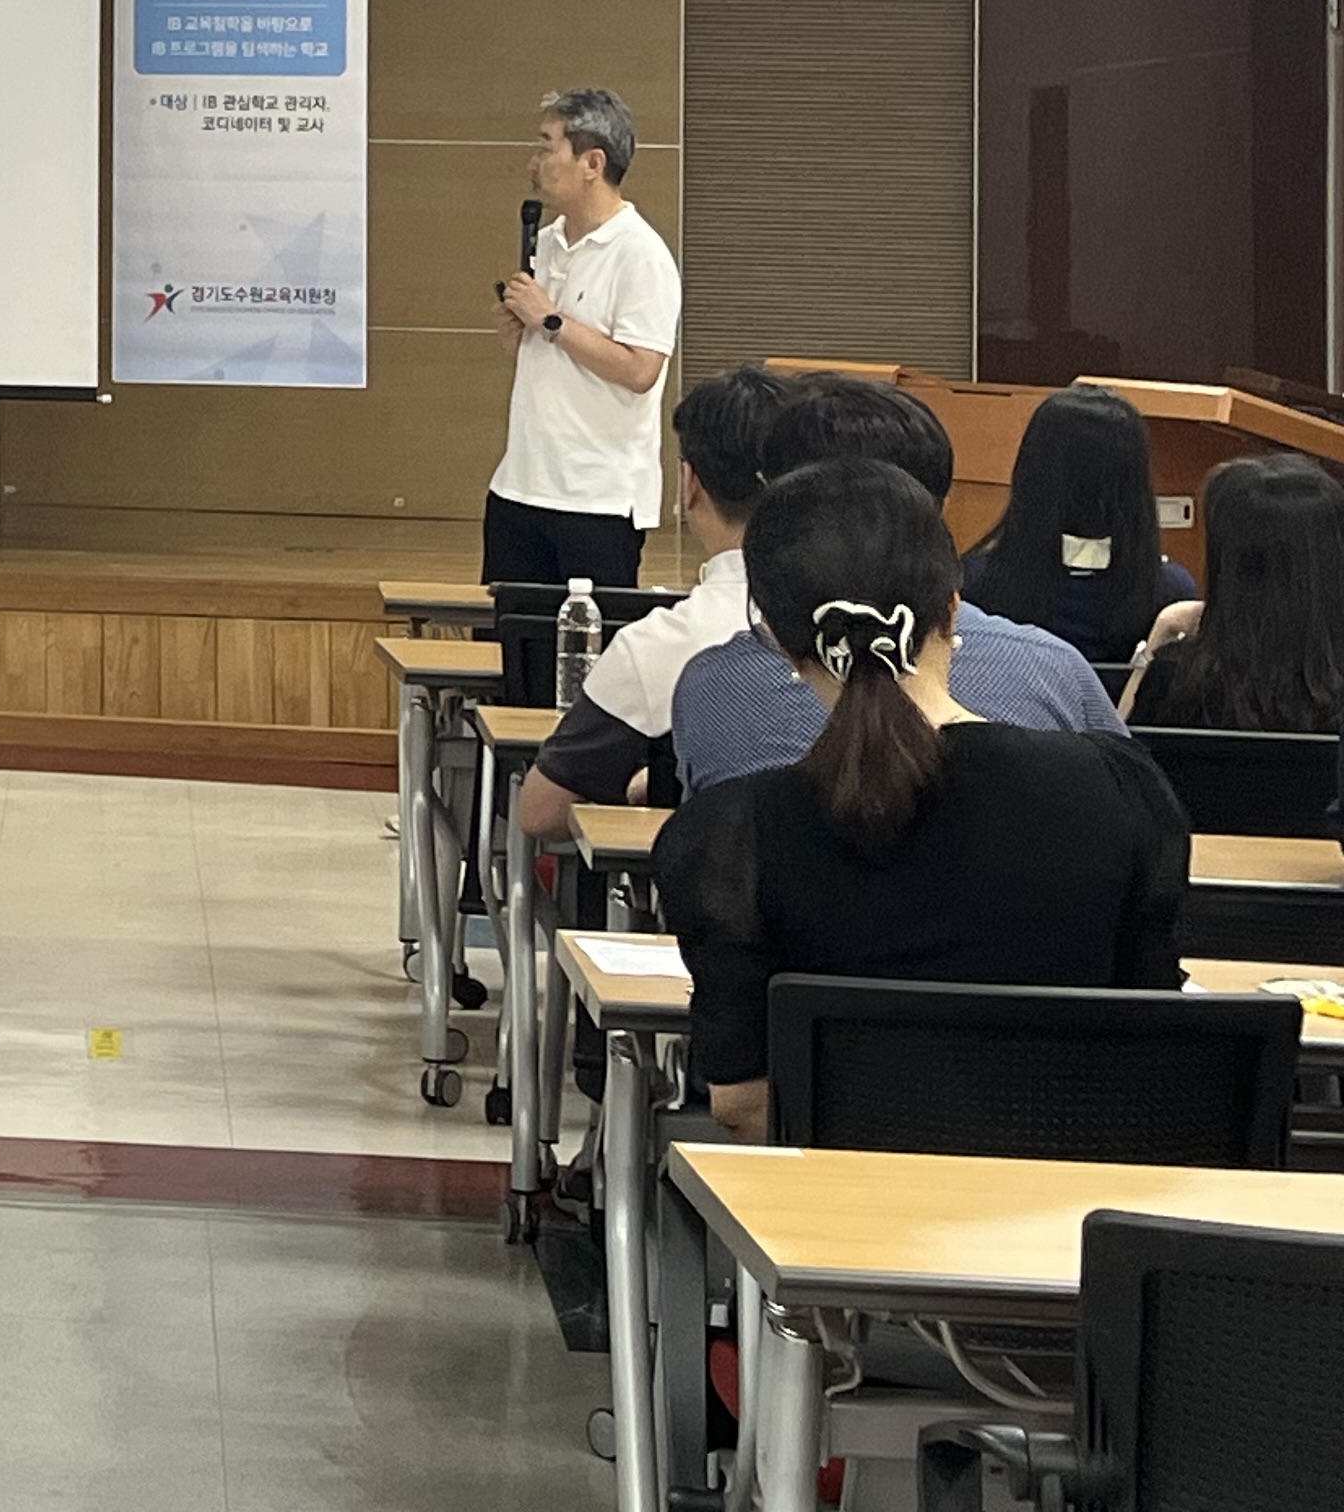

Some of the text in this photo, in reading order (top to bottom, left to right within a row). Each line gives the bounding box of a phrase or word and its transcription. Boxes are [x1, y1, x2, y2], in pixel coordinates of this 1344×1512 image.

[160, 94, 187, 110] 대상
[203, 96, 217, 109] IB
[223, 96, 279, 111] 관심학교
[201, 117, 272, 132] 코디네이터
[296, 118, 324, 132] 교사
[192, 286, 336, 305] 경기도수원교육지원청
